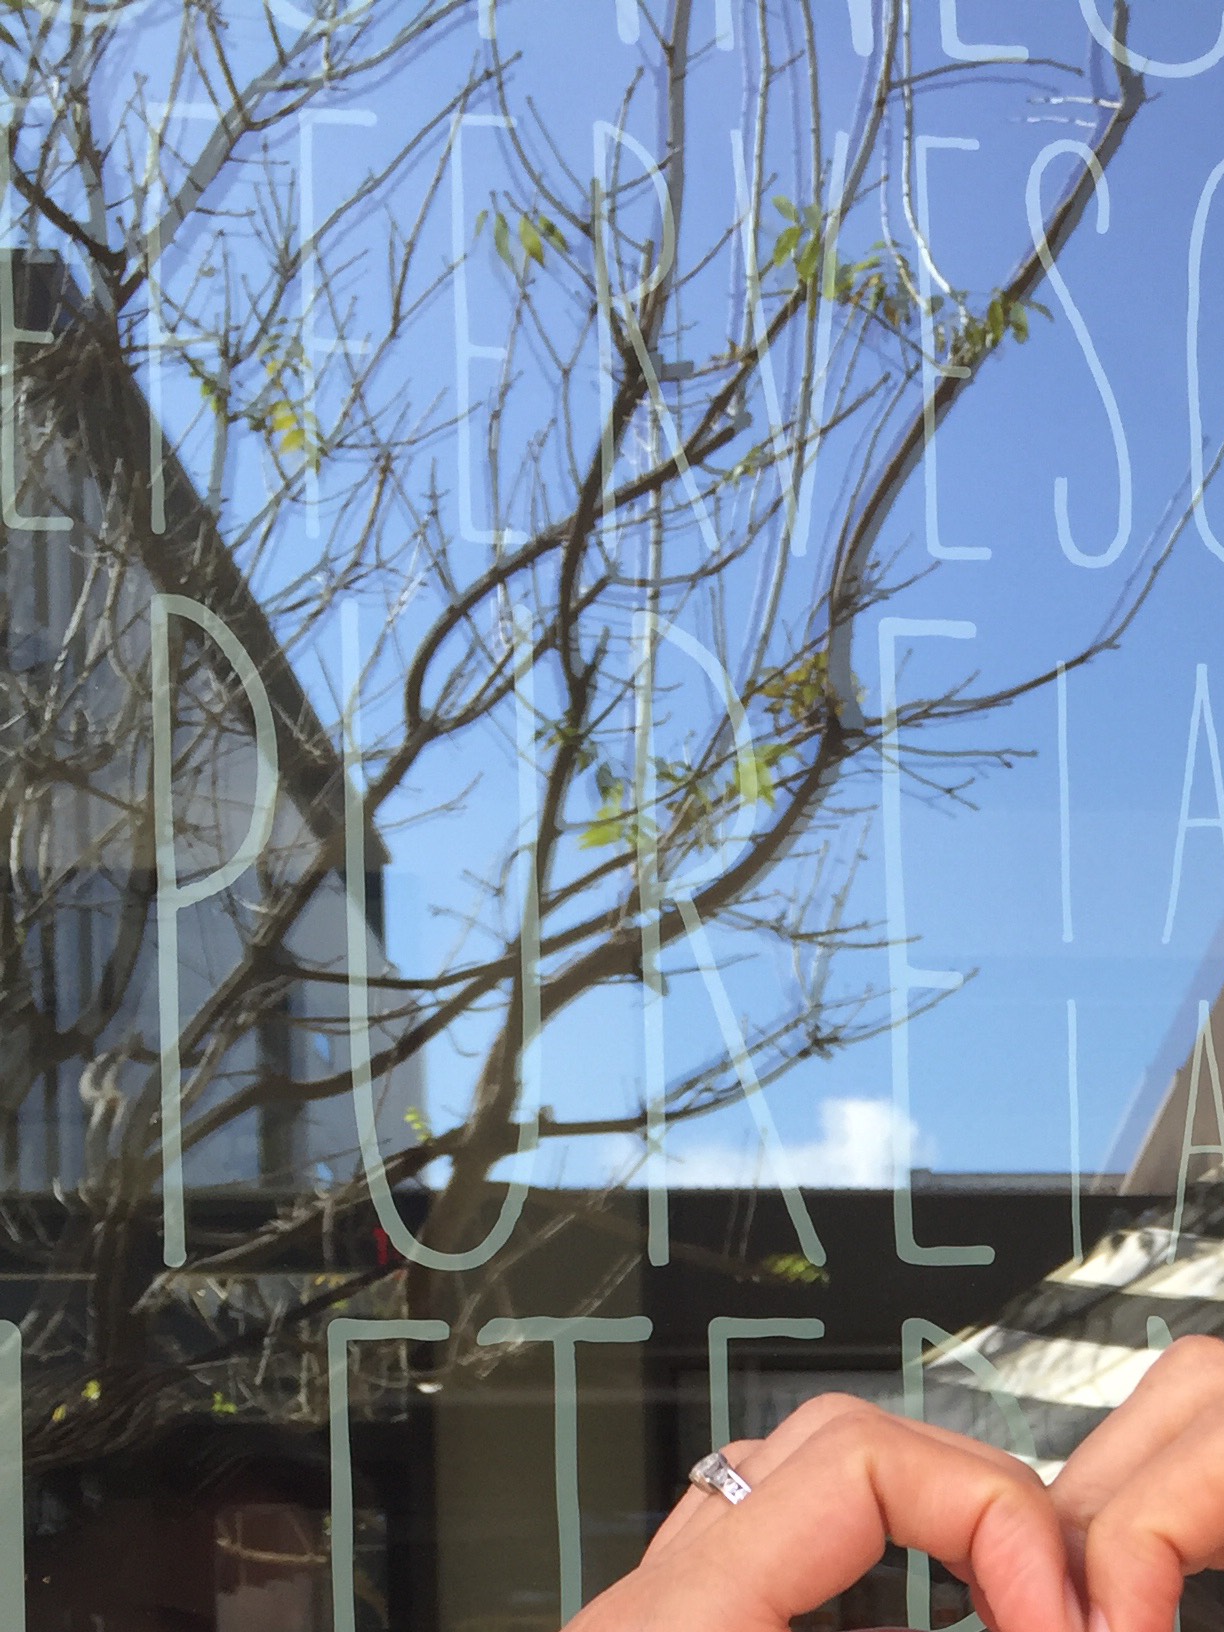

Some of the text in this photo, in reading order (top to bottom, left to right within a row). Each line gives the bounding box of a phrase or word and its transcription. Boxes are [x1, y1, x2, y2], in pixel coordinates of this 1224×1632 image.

[150, 593, 997, 1272] PURE
[1056, 660, 1074, 945] I
[1067, 999, 1084, 1263] I
